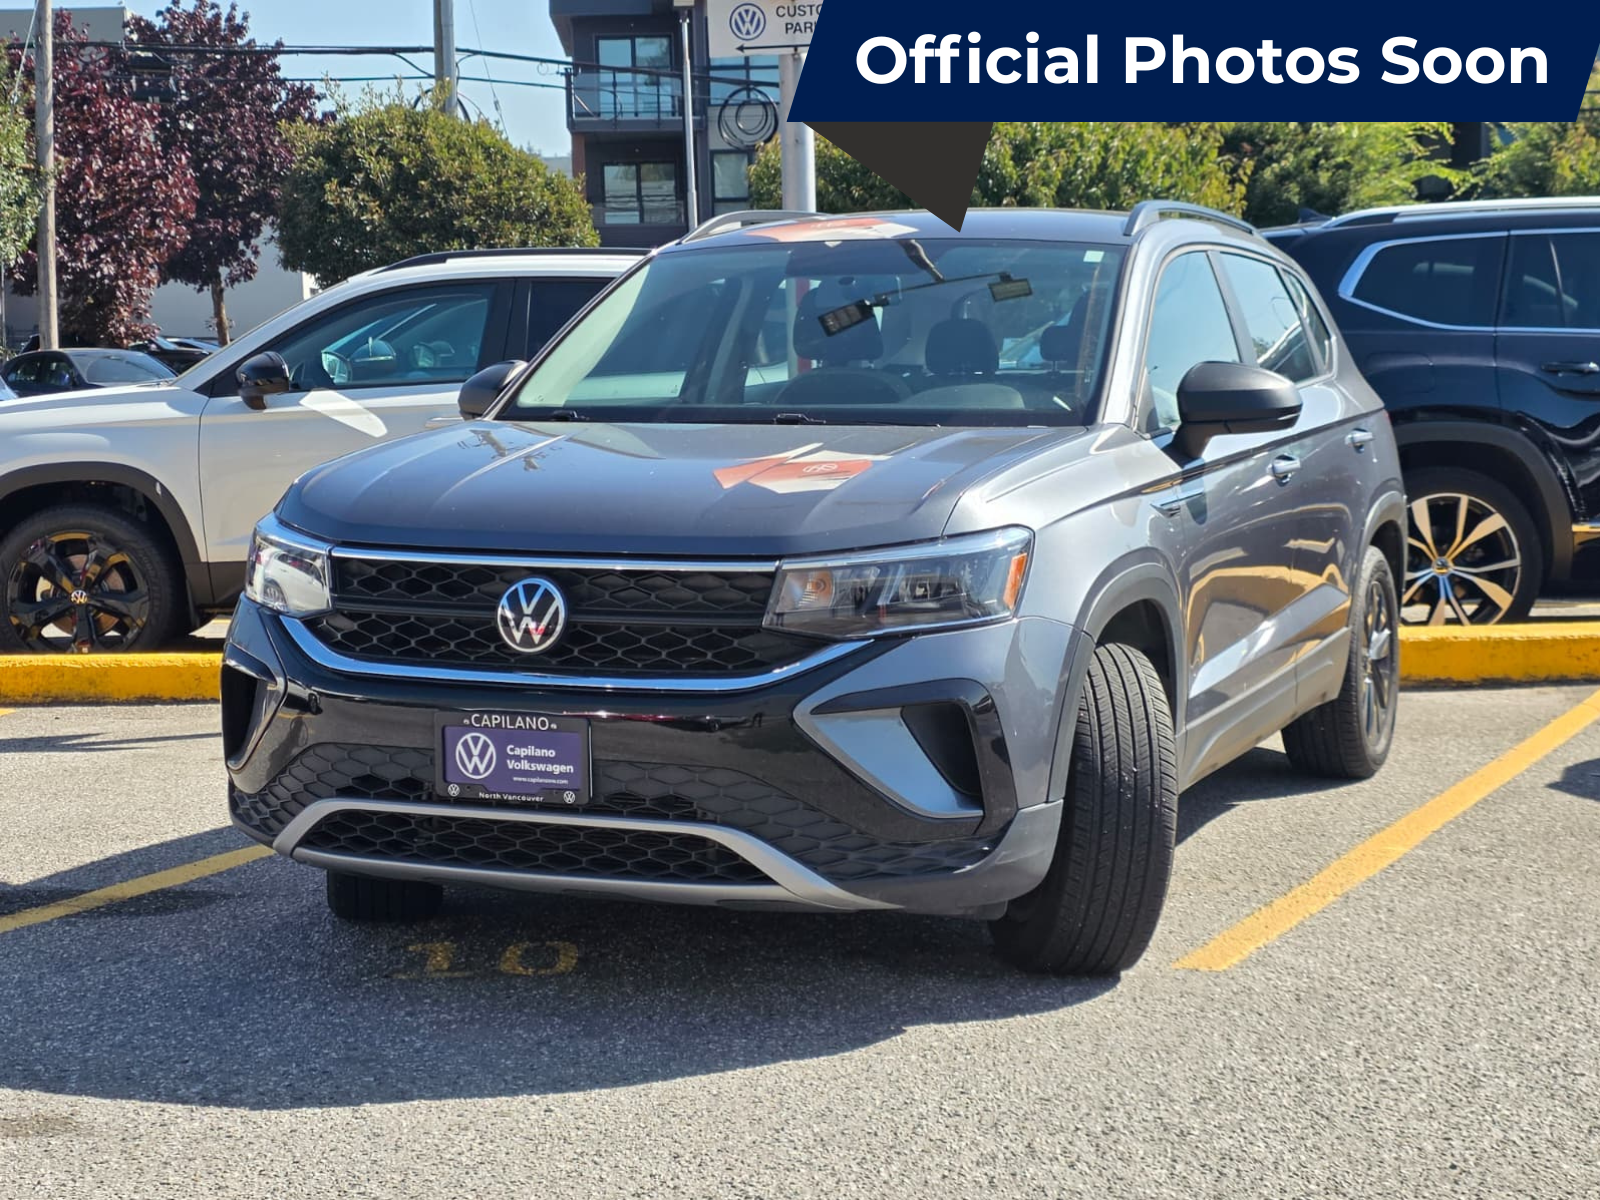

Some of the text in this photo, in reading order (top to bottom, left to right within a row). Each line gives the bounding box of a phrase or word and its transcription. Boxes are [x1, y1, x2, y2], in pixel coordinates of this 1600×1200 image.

[730, 3, 766, 40] VW
[785, 21, 817, 34] PAR
[499, 578, 564, 650] VW
[471, 714, 549, 730] CAPILANO
[456, 733, 496, 778] VW
[506, 744, 556, 758] Capilano
[506, 759, 574, 775] Volkswagen
[478, 791, 545, 802] North Vancouver
[394, 941, 579, 977] 10
